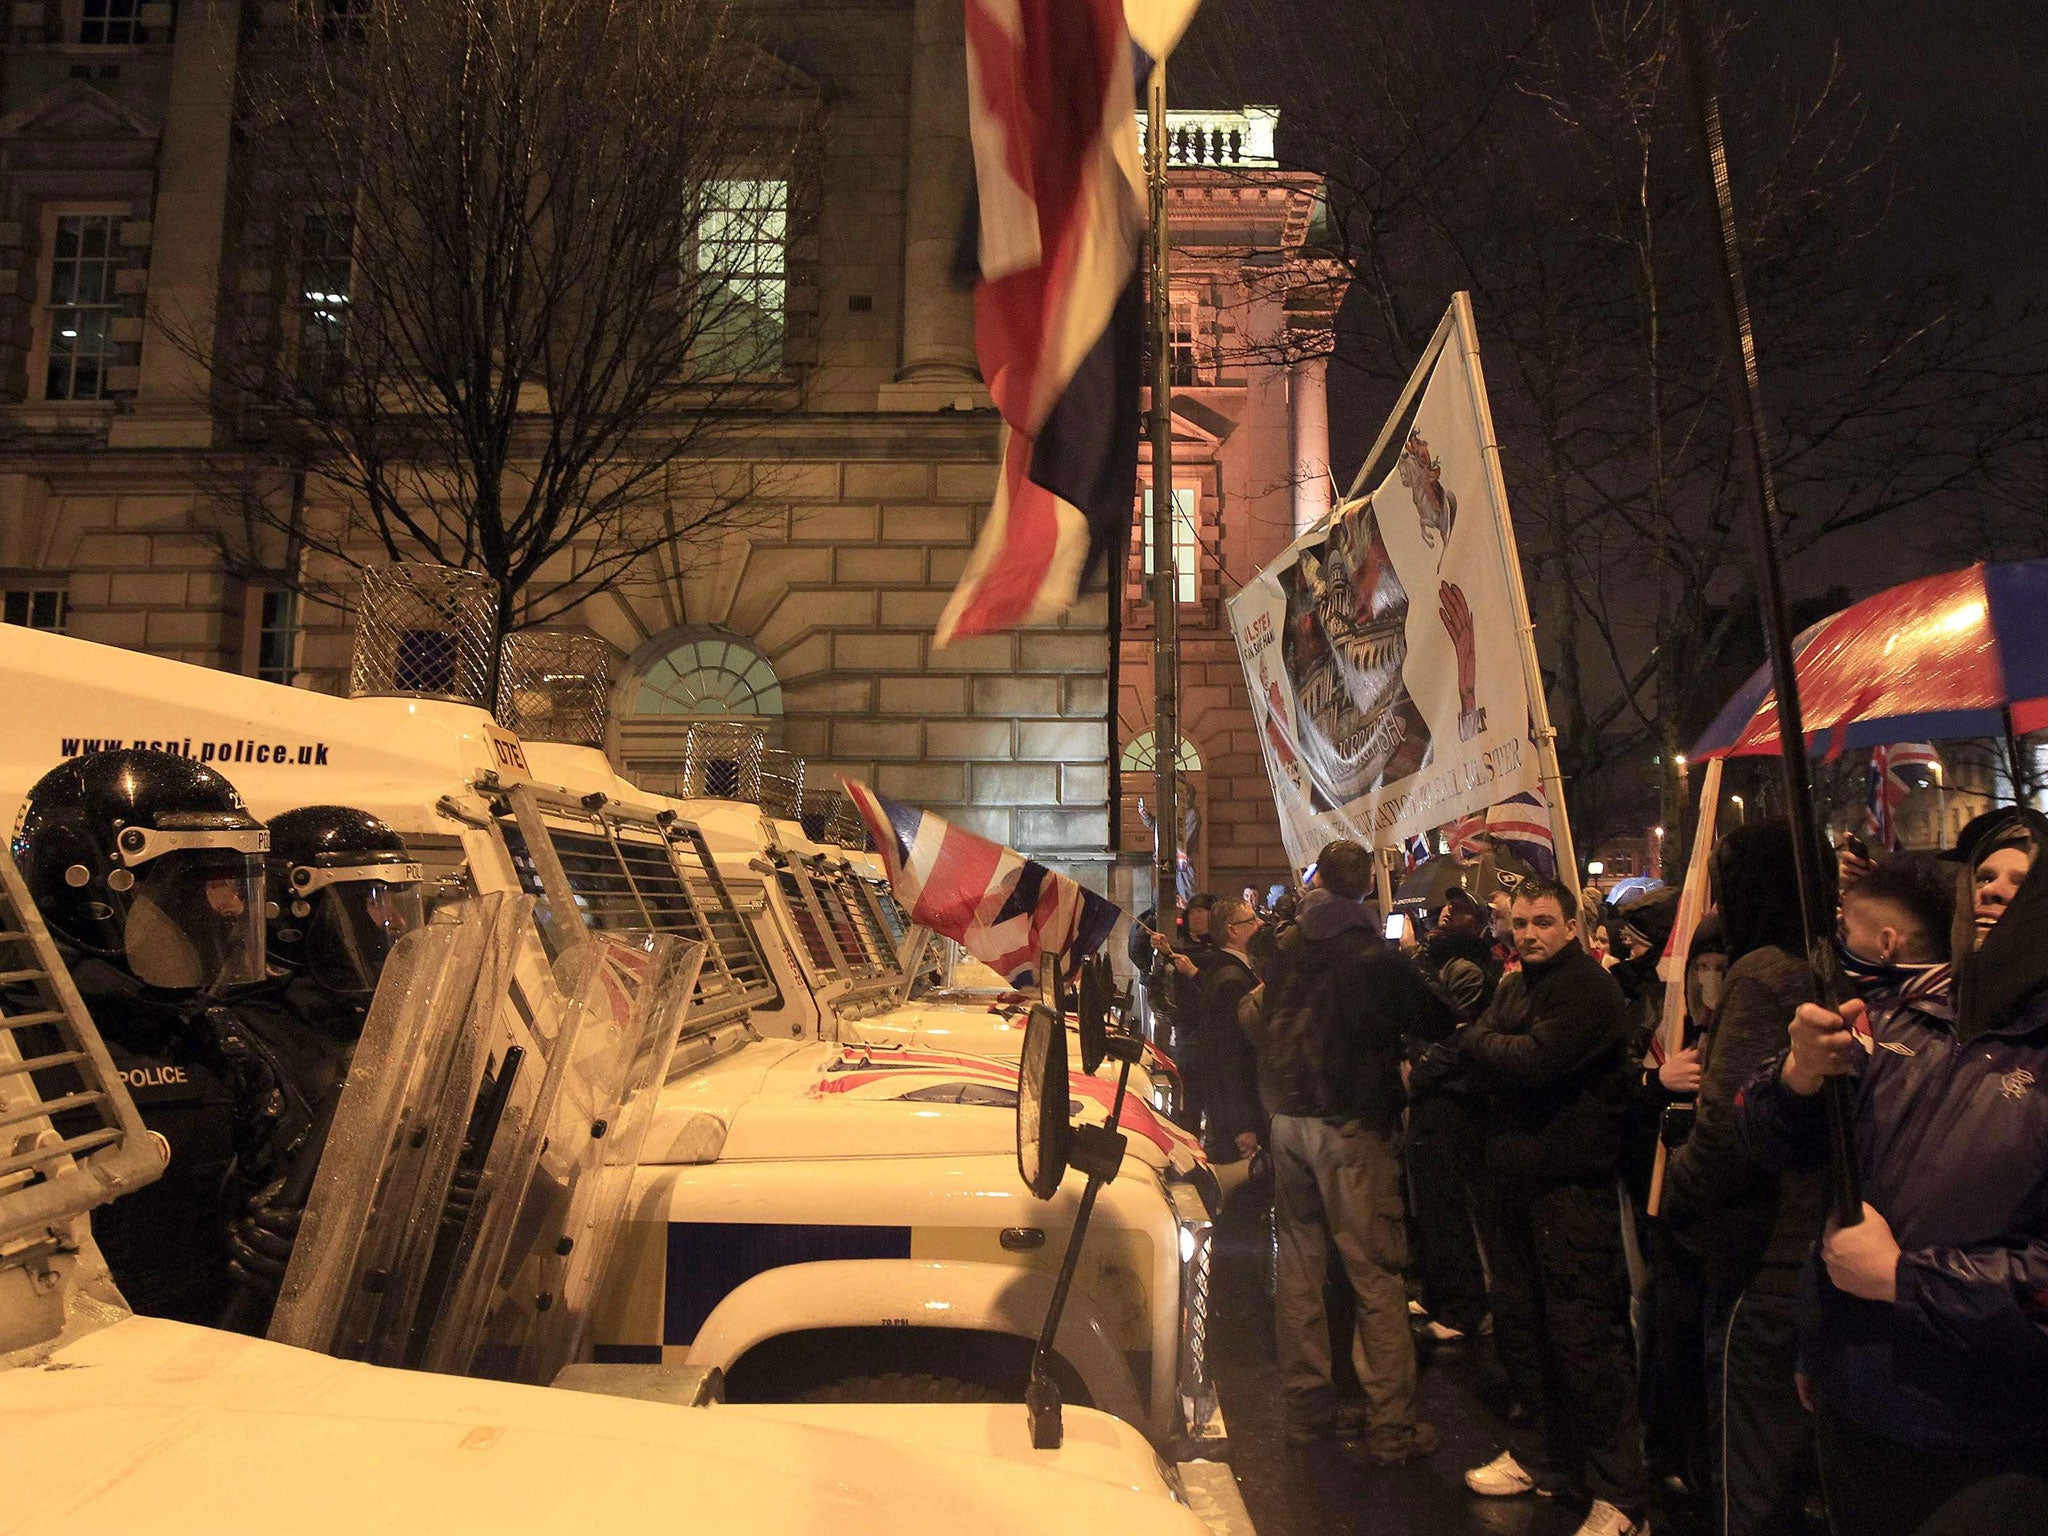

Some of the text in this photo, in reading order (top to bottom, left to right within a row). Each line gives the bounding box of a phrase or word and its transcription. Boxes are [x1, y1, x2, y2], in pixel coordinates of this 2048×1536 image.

[61, 738, 329, 765] wwwsni.police.uk
[1462, 738, 1522, 791] ULSTER
[117, 1066, 188, 1088] POLICE
